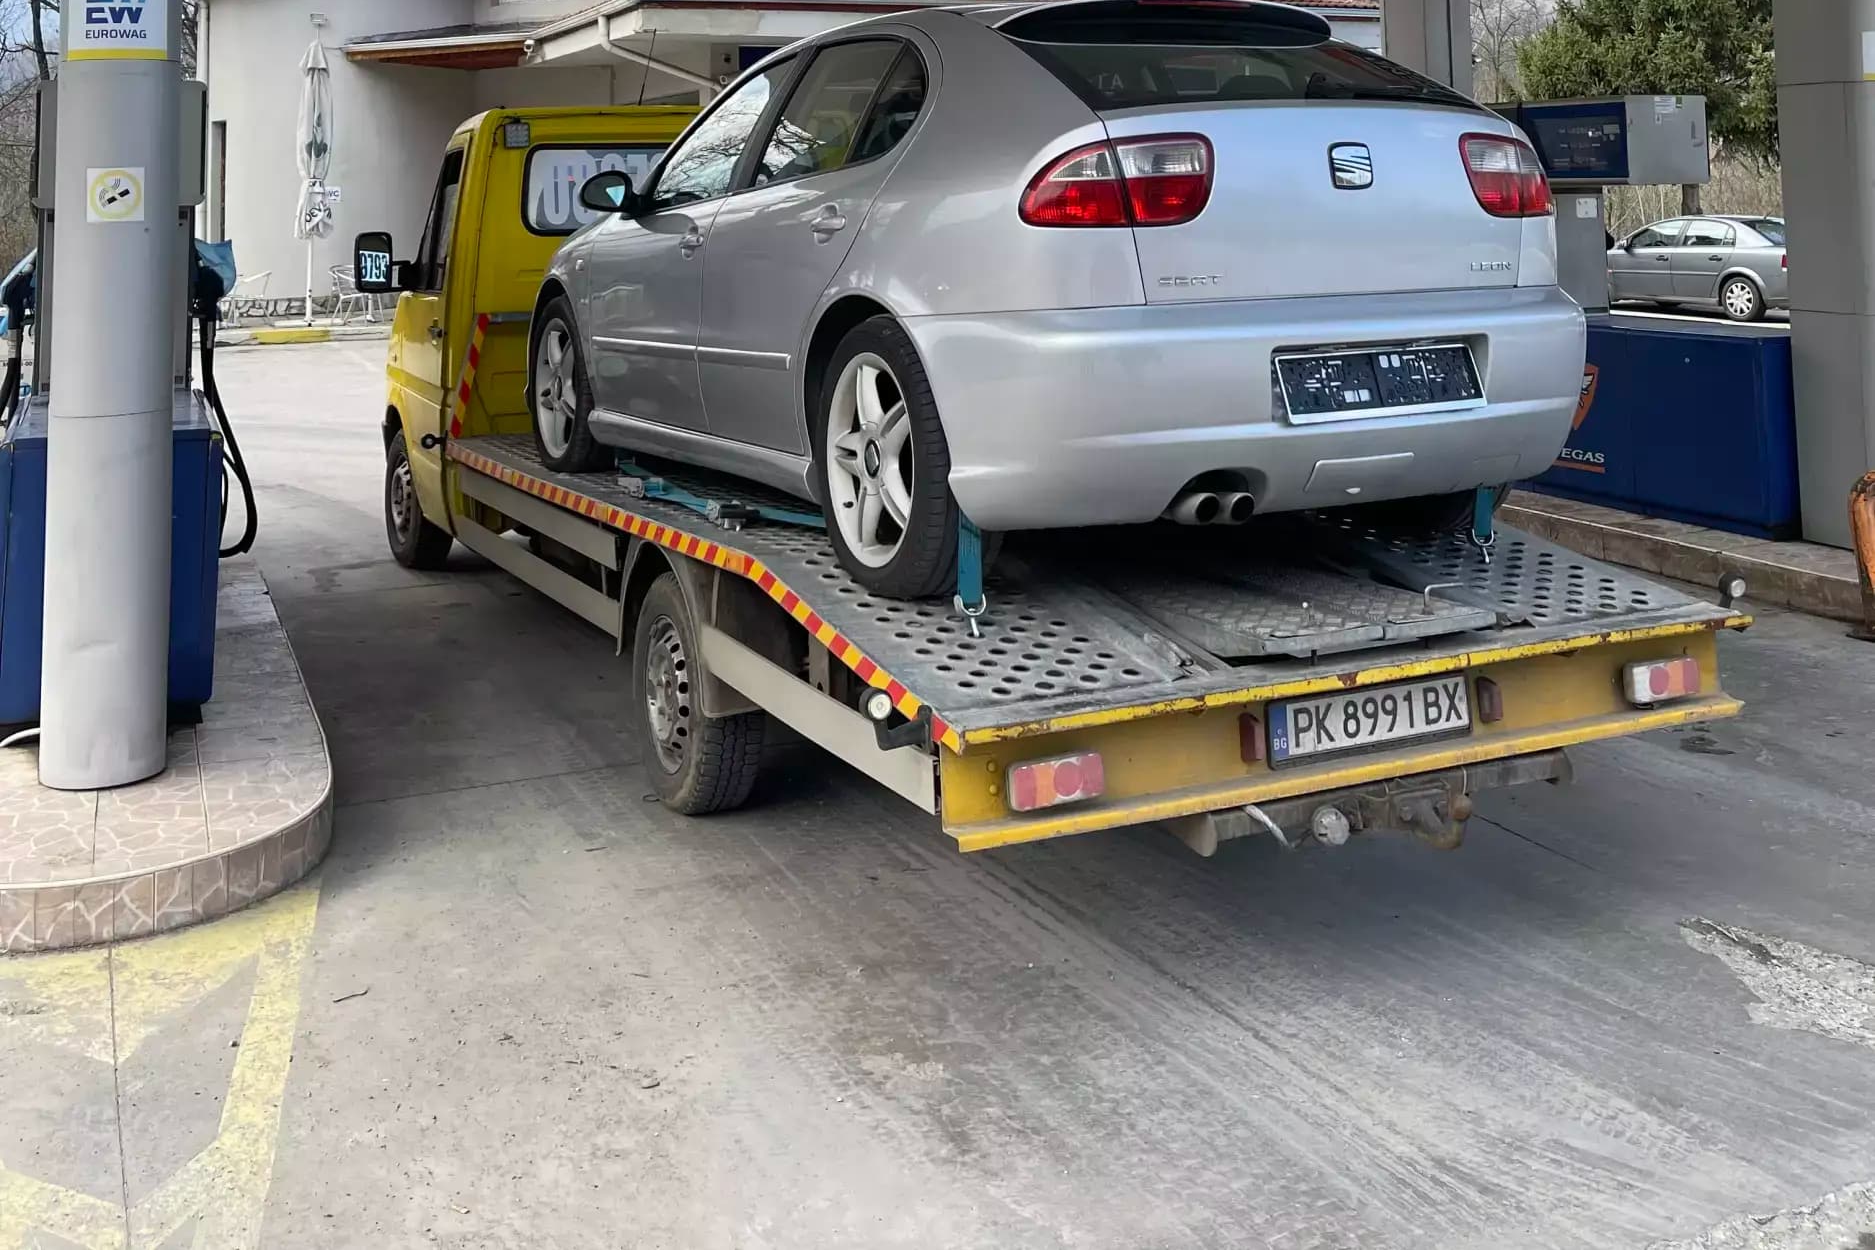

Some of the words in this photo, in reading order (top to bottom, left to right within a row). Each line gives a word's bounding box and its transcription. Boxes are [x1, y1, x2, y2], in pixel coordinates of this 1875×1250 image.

[85, 28, 147, 40] EUROWAG
[1469, 261, 1513, 272] LEON
[1158, 273, 1224, 287] SEAT
[1560, 448, 1605, 463] EGAS
[1293, 702, 1337, 749] PK
[1343, 690, 1415, 740] 8991
[1422, 681, 1464, 727] BX
[1273, 737, 1288, 750] BG
